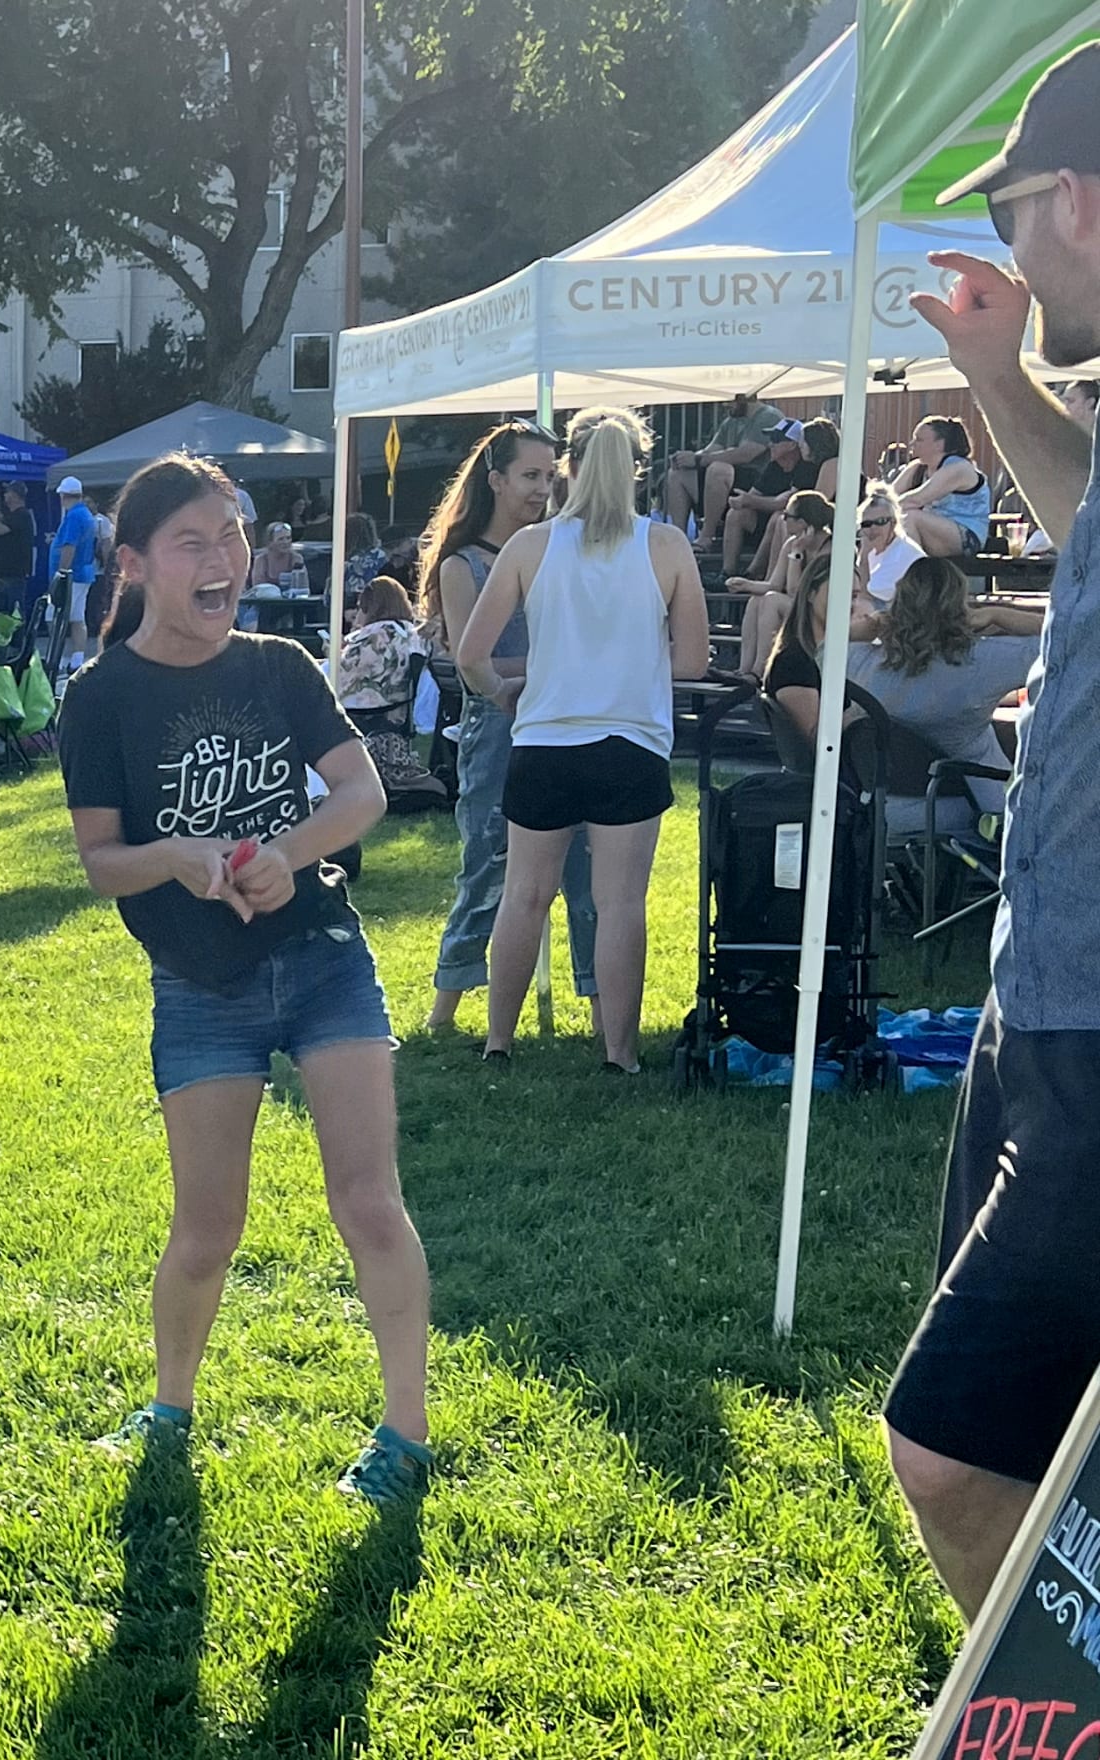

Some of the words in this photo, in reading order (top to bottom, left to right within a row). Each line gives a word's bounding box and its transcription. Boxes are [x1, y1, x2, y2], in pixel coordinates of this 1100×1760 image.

[567, 271, 792, 312] CENTURY
[805, 269, 843, 303] 21
[466, 290, 517, 337] CENTURY
[656, 319, 763, 338] Tri-Cities
[195, 734, 232, 766] BE
[156, 736, 291, 836] Light
[236, 812, 265, 836] THE
